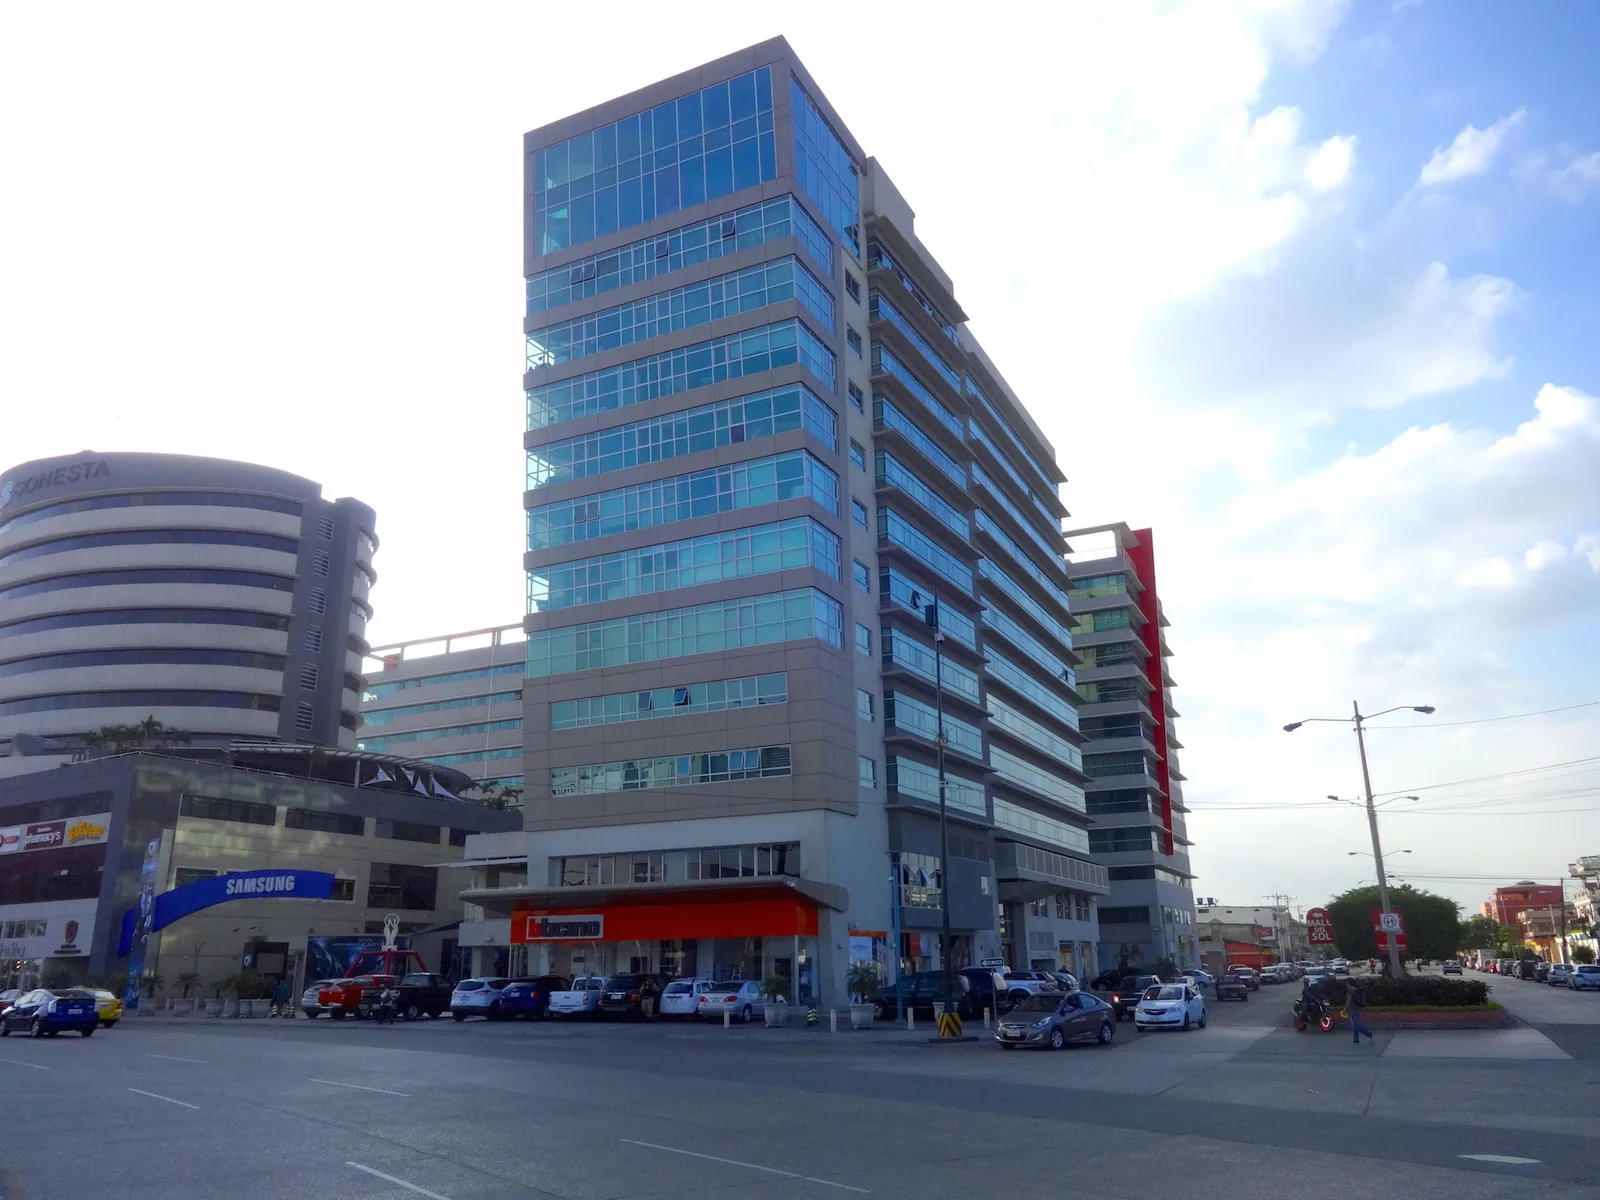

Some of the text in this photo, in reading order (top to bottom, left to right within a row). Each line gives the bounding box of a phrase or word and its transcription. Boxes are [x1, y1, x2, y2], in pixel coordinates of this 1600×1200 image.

[14, 460, 109, 497] SONESTA
[226, 875, 296, 895] SAMSUNG
[1307, 919, 1332, 927] MALL
[1311, 932, 1332, 941] SOL
